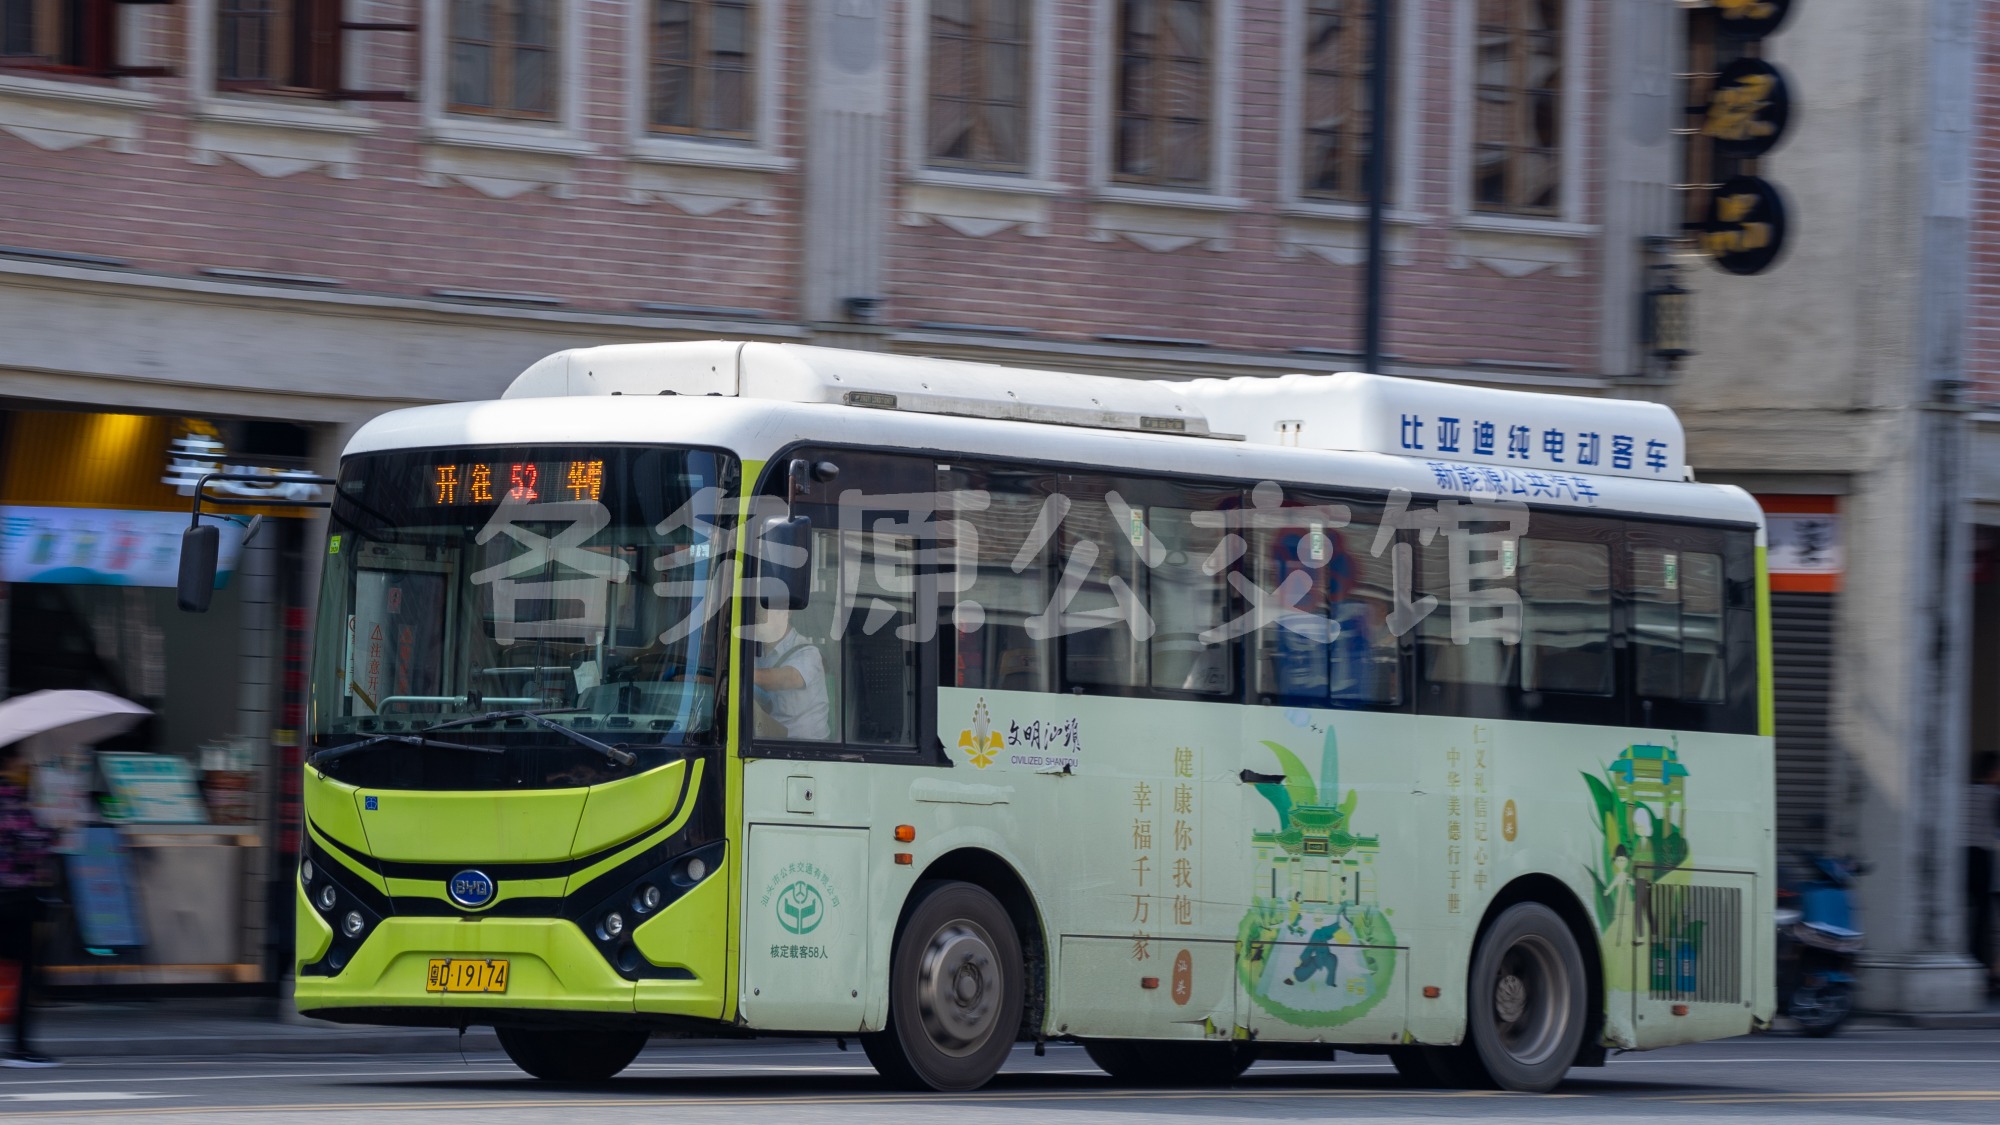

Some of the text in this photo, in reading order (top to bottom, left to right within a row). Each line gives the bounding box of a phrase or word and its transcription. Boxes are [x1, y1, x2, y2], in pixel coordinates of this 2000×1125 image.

[1401, 413, 1669, 473] 比亚迪纯电动客车
[436, 464, 493, 504] 开往
[511, 463, 538, 499] 52
[1427, 461, 1600, 504] 新能源公共汽车
[367, 643, 382, 704] 注意开门
[1011, 755, 1079, 768] CIVILIZED SHANTOU
[1446, 747, 1462, 915] 中华美德行于世
[1473, 724, 1488, 892] 仁义礼信记心中
[1172, 746, 1194, 926] 健康你我他
[455, 880, 487, 896] BYD
[760, 861, 840, 908] 汕头市公共交通有限公司
[1131, 781, 1152, 962] 幸福千万家
[770, 944, 829, 960] 核定载客58人
